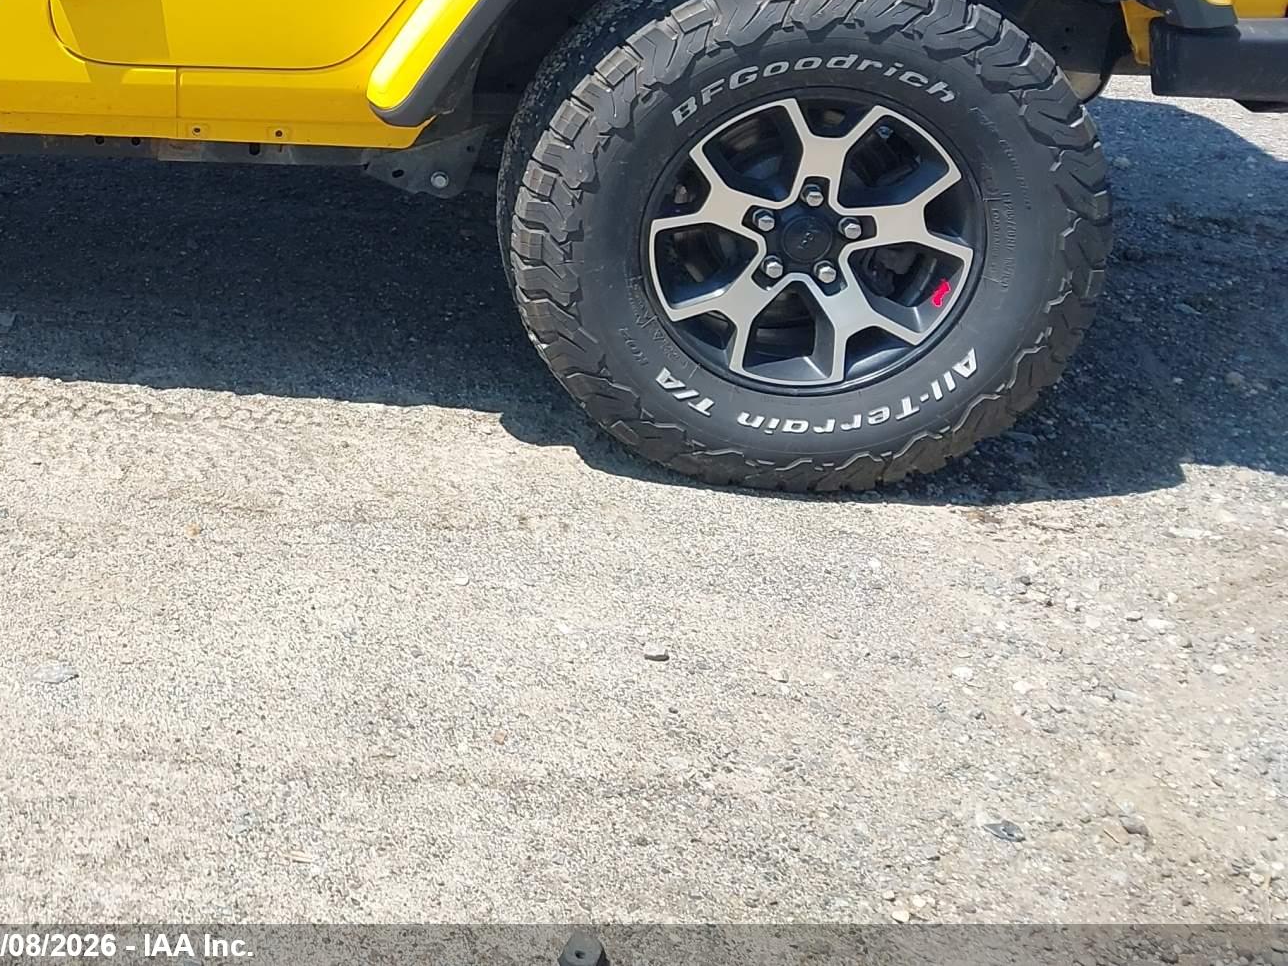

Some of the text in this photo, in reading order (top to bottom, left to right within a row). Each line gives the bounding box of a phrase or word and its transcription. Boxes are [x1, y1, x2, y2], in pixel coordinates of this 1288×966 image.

[671, 53, 956, 127] BFGoodrich
[655, 366, 715, 418] T/A
[736, 347, 978, 435] All-Terrain
